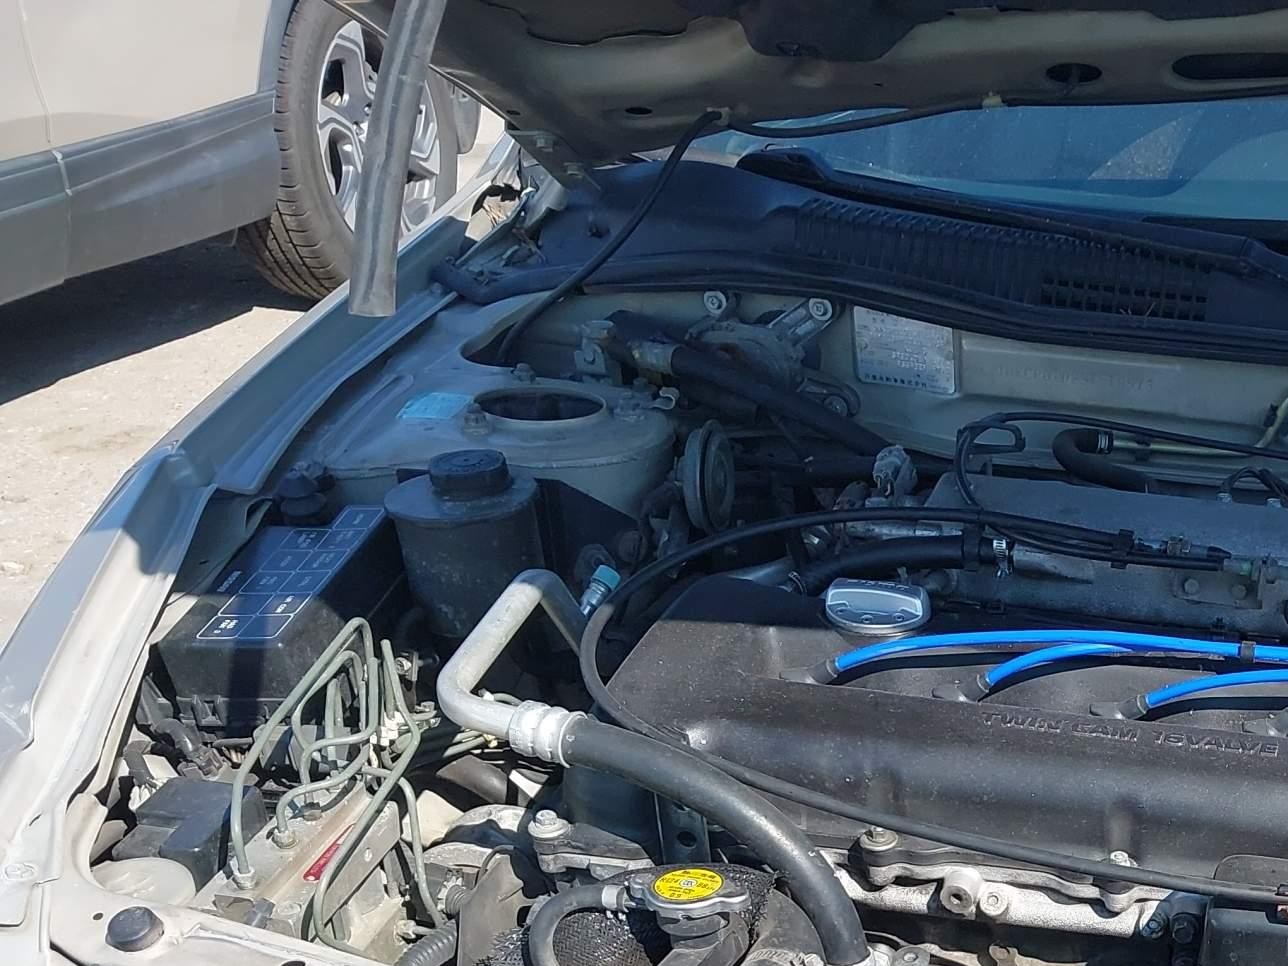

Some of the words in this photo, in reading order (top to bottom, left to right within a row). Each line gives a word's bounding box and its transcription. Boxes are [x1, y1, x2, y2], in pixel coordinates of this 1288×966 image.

[982, 712, 1068, 734] TWIN
[1071, 722, 1141, 743] CAM
[1152, 730, 1281, 759] 16VALVE
